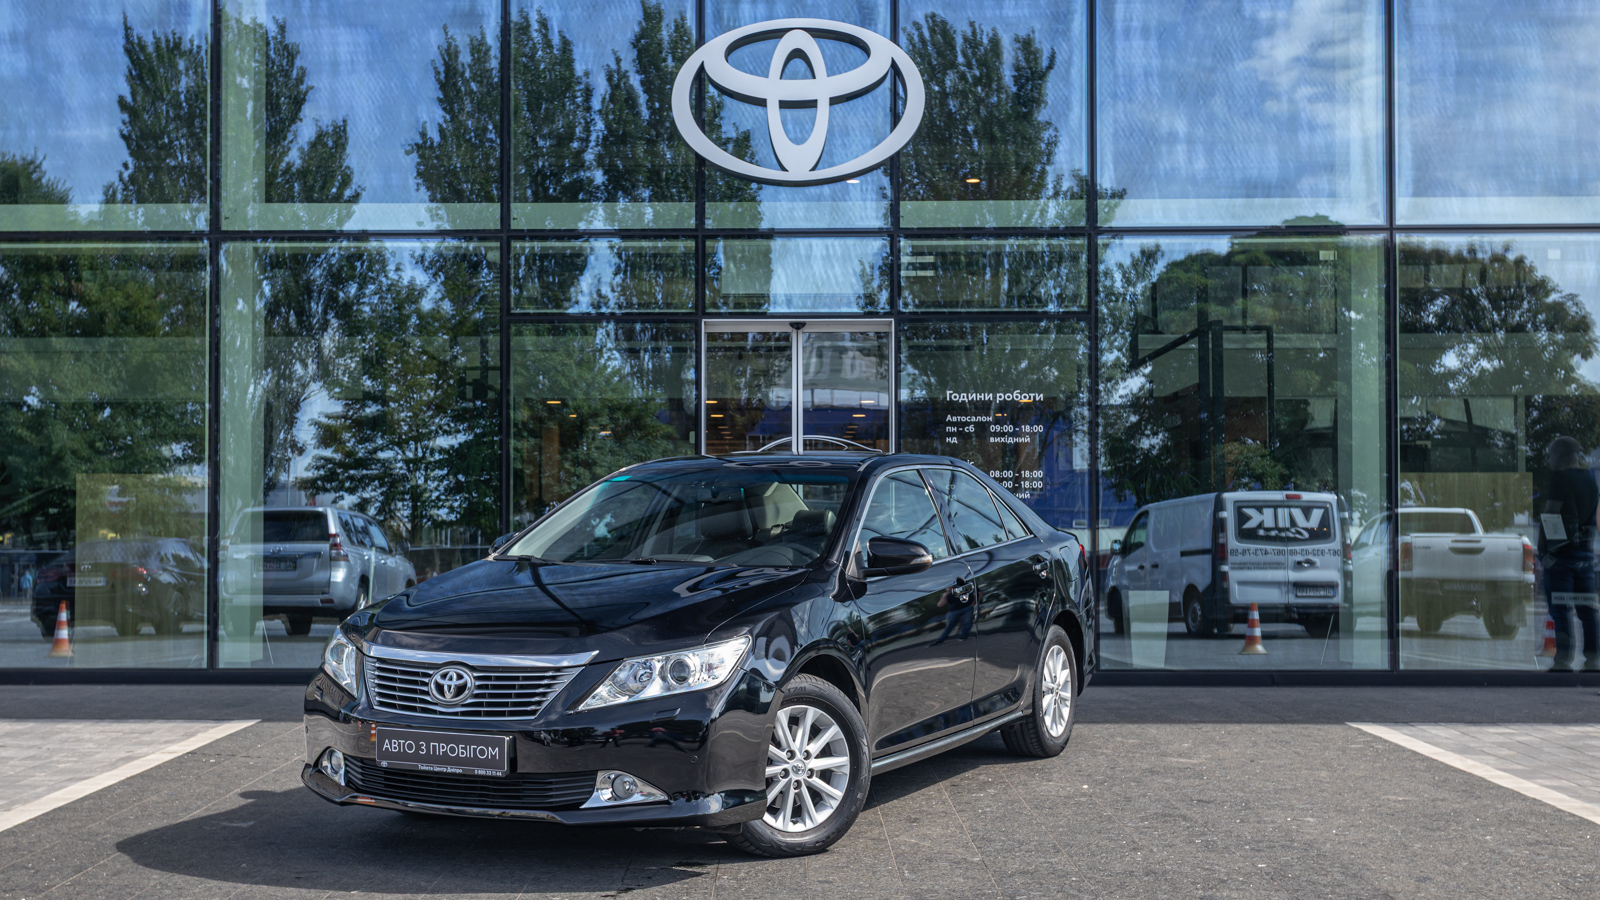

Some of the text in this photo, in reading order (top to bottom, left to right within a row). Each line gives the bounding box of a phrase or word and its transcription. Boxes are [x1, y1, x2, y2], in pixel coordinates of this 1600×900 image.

[946, 390, 1044, 403] Години роботи
[945, 414, 993, 422] Автосалон
[945, 425, 957, 433] пн
[964, 424, 975, 433] сб
[989, 424, 1014, 433] 09:00
[1021, 424, 1044, 433] 18:00
[945, 436, 958, 444] нд
[989, 435, 1031, 444] вихідний
[989, 470, 1014, 478] 08:00
[1021, 470, 1044, 478] 18:00
[1021, 480, 1043, 489] 18:00
[382, 739, 415, 754] АВТО
[430, 742, 499, 760] ПРОБІГОМ
[447, 766, 463, 774] Дніпро
